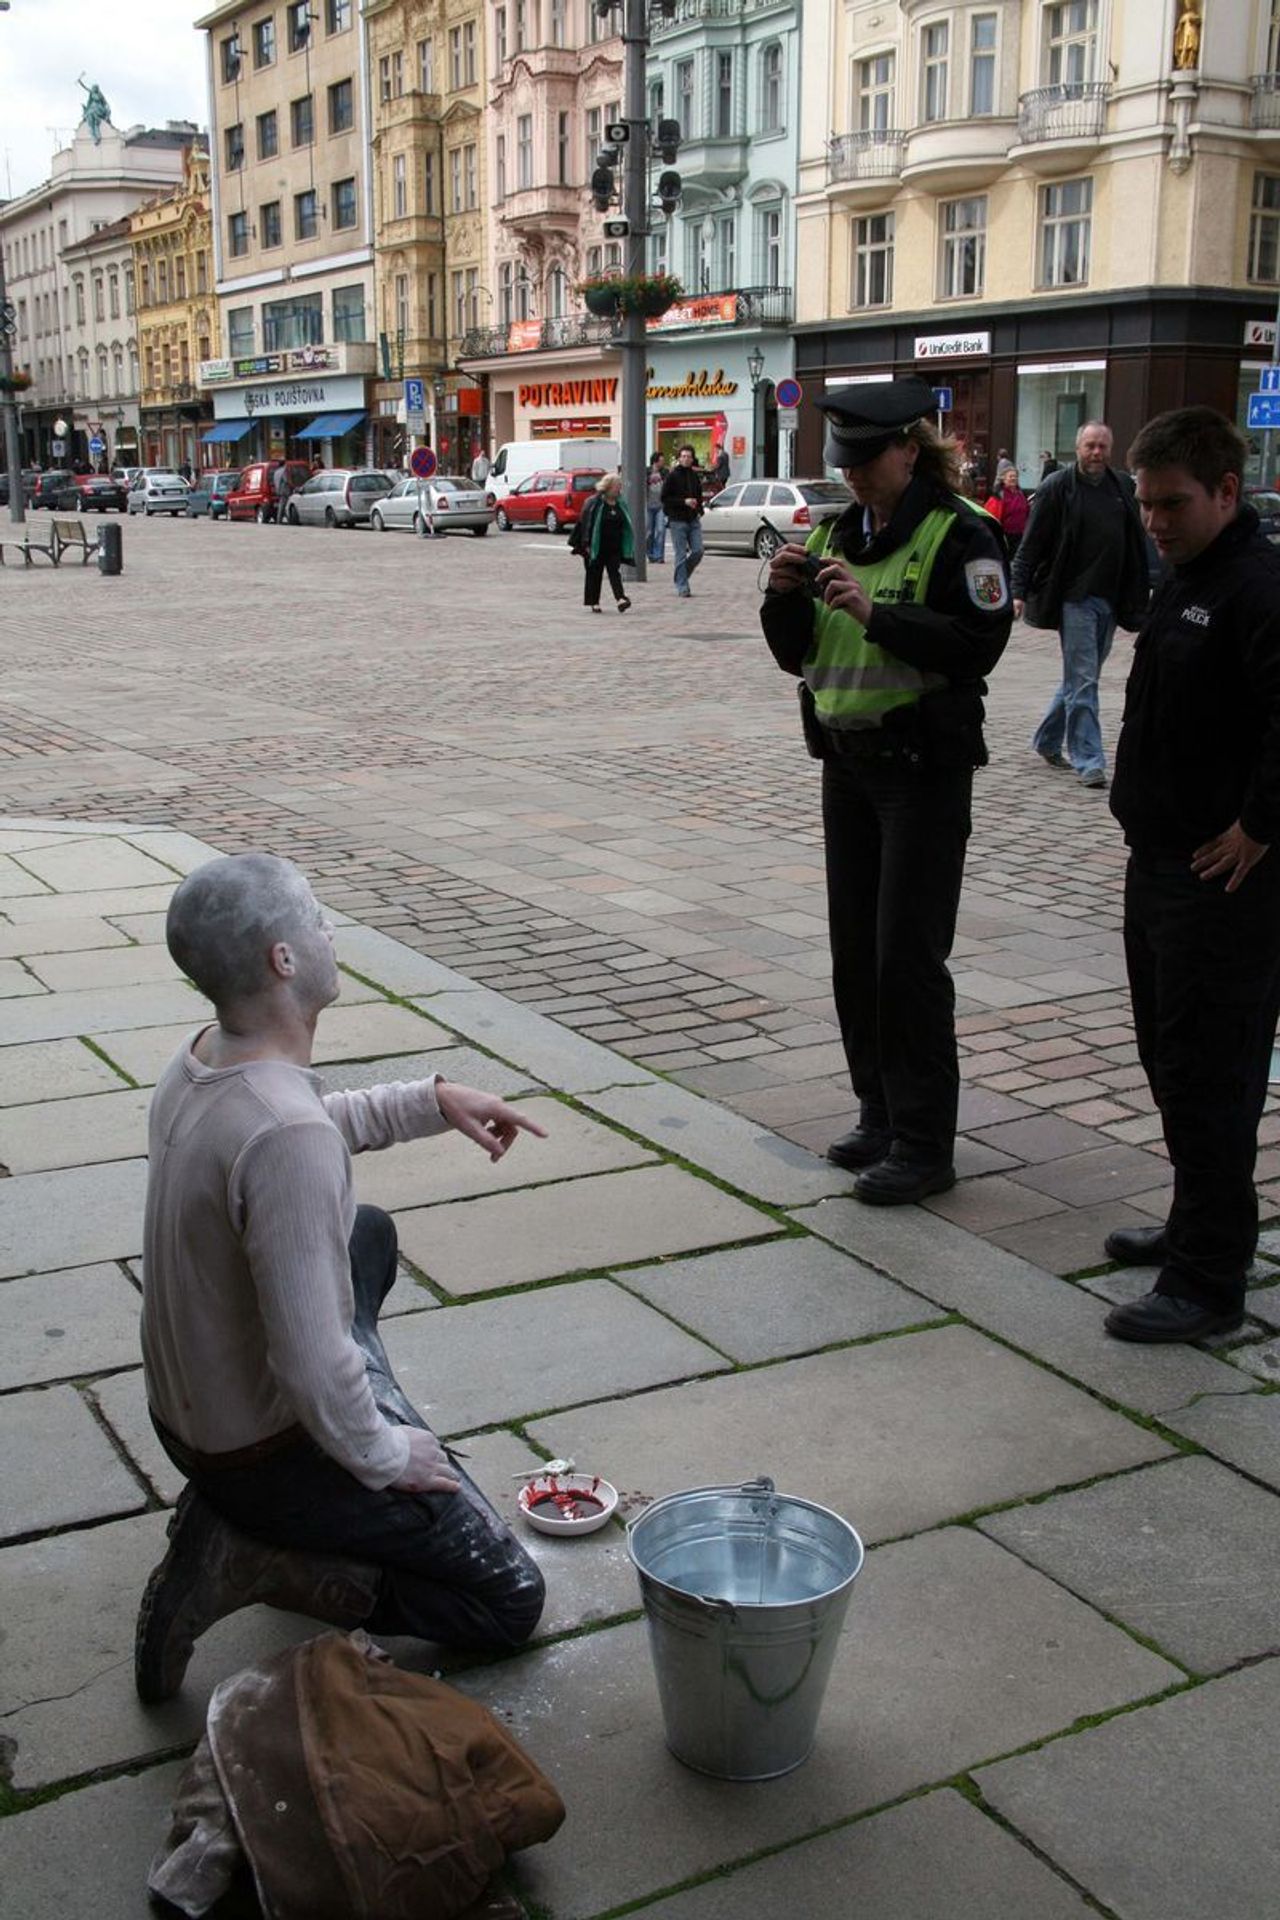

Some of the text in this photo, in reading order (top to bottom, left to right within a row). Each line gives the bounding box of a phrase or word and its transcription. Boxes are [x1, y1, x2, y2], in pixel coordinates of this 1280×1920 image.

[929, 338, 984, 354] UniCredit Bank
[518, 378, 618, 407] POTRAVINY
